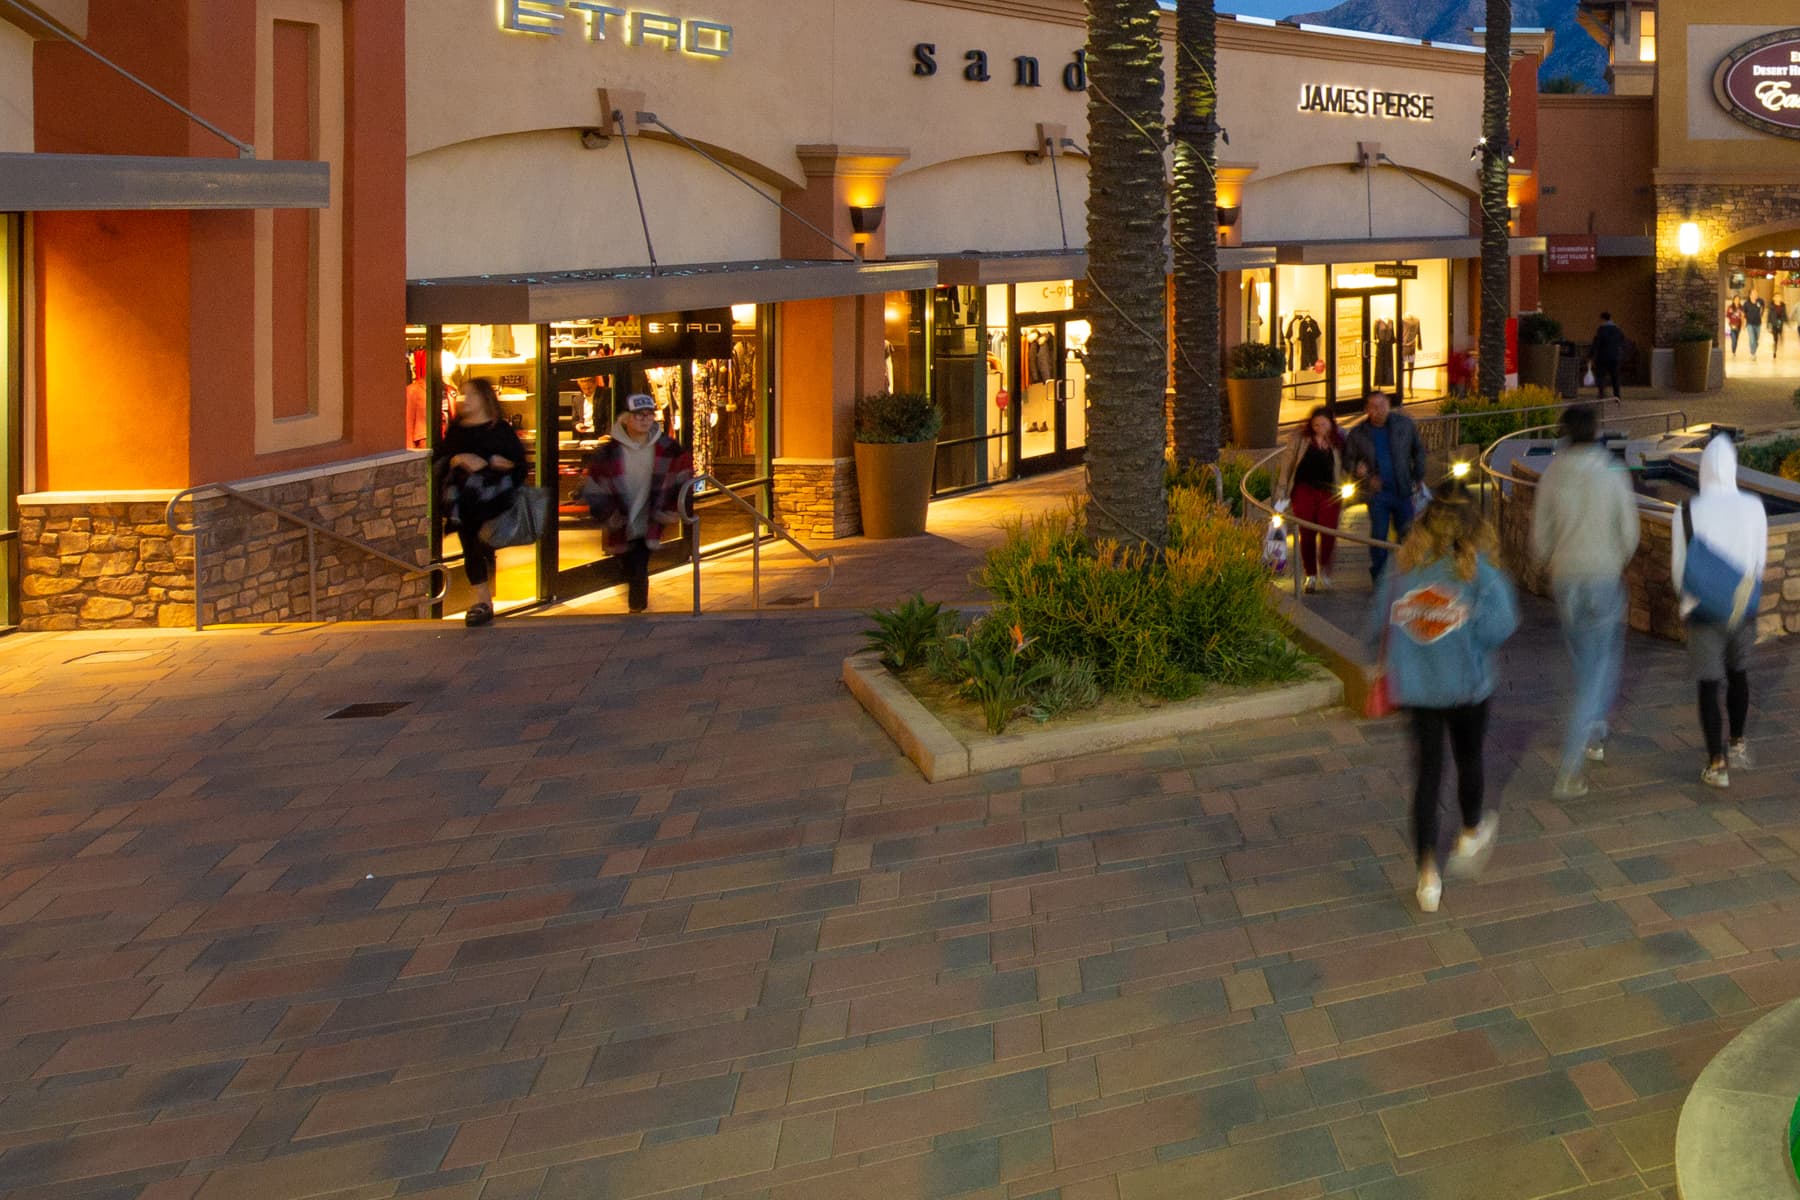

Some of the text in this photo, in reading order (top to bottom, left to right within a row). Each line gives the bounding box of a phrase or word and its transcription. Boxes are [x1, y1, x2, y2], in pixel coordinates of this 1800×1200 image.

[913, 42, 1090, 93] sand
[1299, 84, 1435, 120] JAMES PERSE
[648, 322, 722, 334] ETRO
